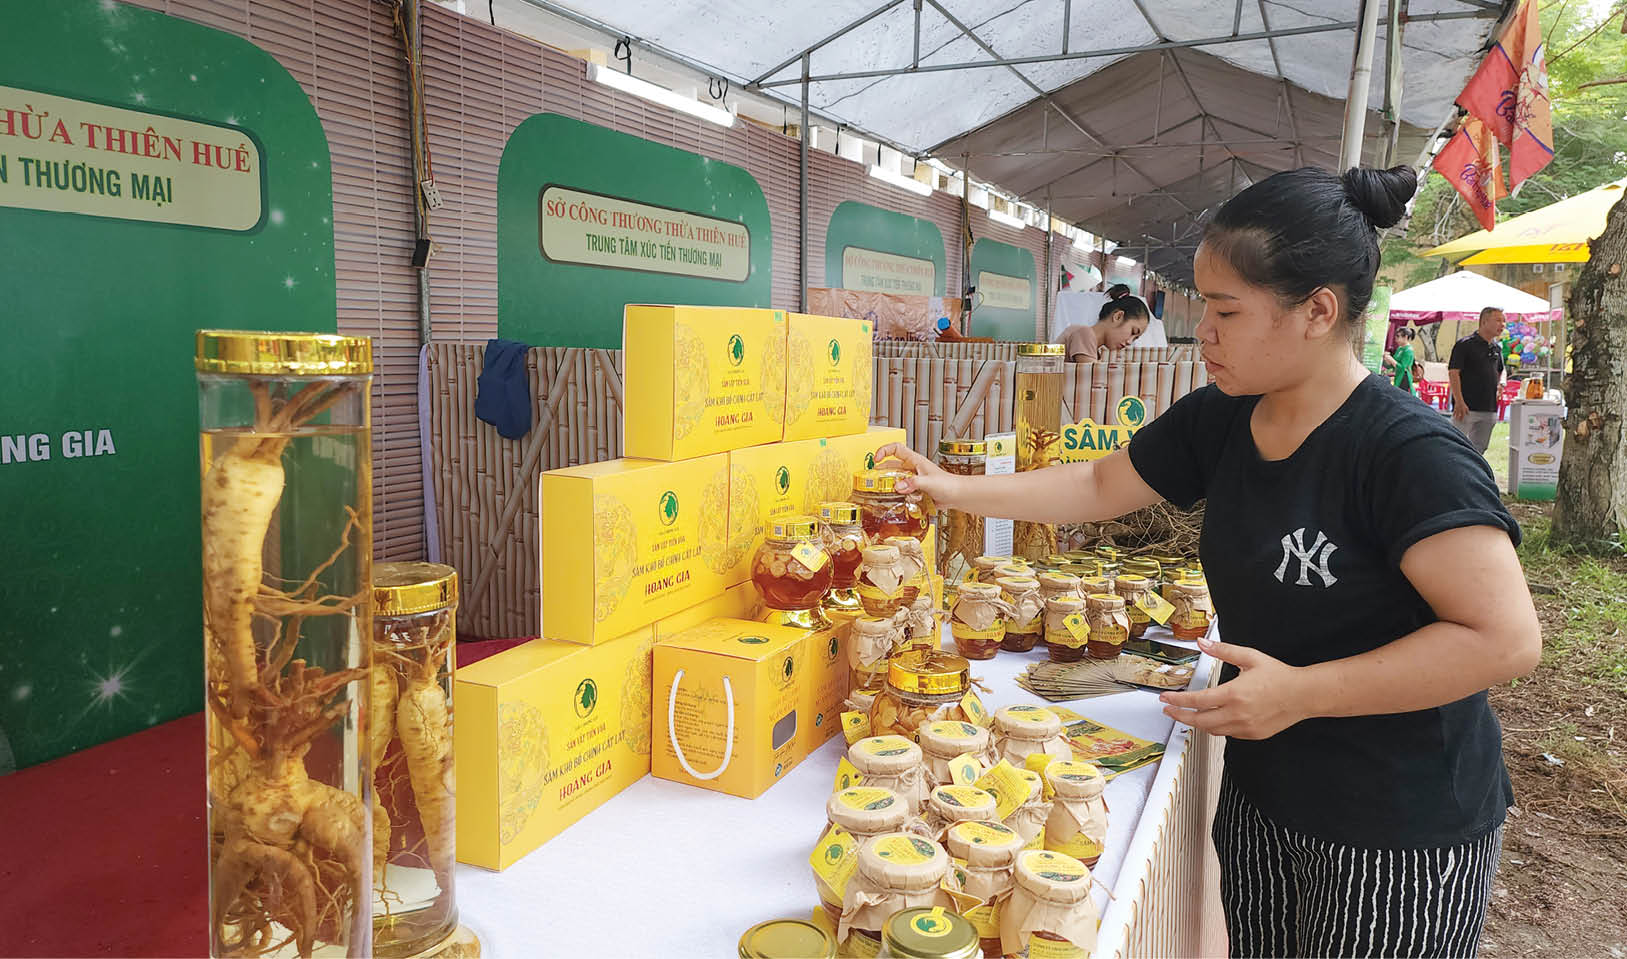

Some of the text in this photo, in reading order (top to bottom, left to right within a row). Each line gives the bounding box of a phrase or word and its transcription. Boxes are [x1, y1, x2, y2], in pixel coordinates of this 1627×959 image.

[80, 122, 183, 162] THIÊN
[191, 141, 251, 173] HUẾ
[18, 156, 121, 197] THƯƠNG
[131, 173, 173, 207] MẠI
[546, 196, 566, 218] SỞ
[569, 201, 608, 225] CÔNG
[611, 211, 662, 235] THƯƠNG
[664, 220, 694, 241] THỪA
[696, 225, 726, 245] THIÊN
[585, 233, 722, 270] TRUNG TÂM XÚC TIẾN THƯƠNG MẠI
[0, 429, 116, 464] NG GIA
[1064, 423, 1118, 450] SÂM
[676, 569, 690, 584] GIA
[596, 759, 612, 778] GIA
